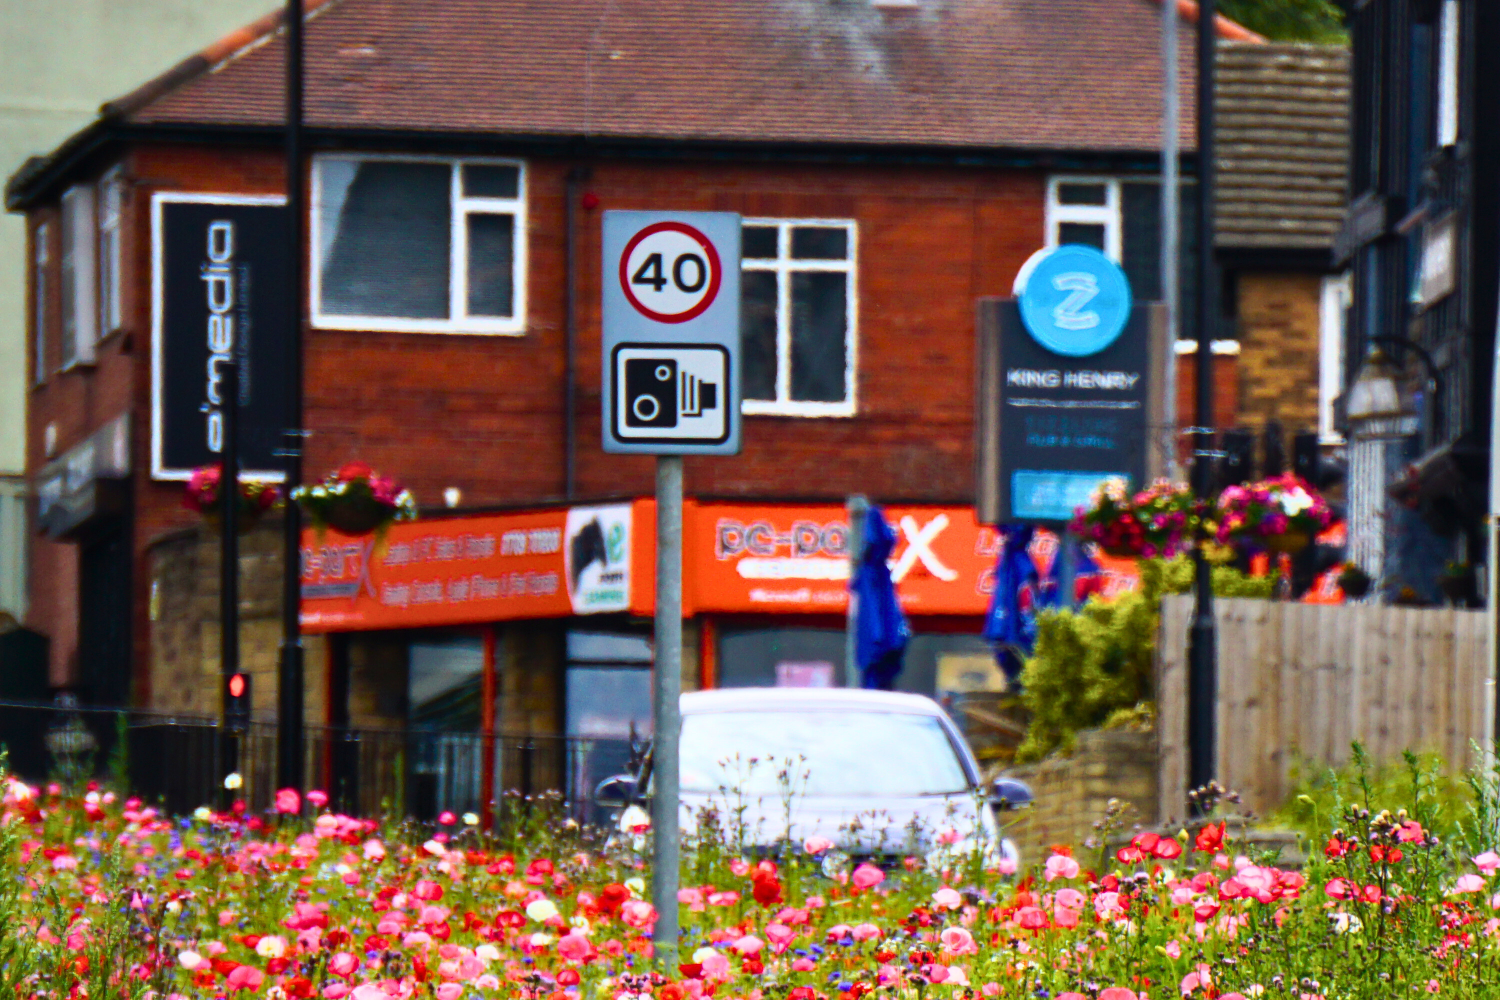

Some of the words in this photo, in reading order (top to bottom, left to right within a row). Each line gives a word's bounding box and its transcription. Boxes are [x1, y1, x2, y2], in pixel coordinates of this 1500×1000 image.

[631, 252, 708, 294] 40
[1006, 367, 1061, 388] KING
[1063, 369, 1141, 390] HENRY
